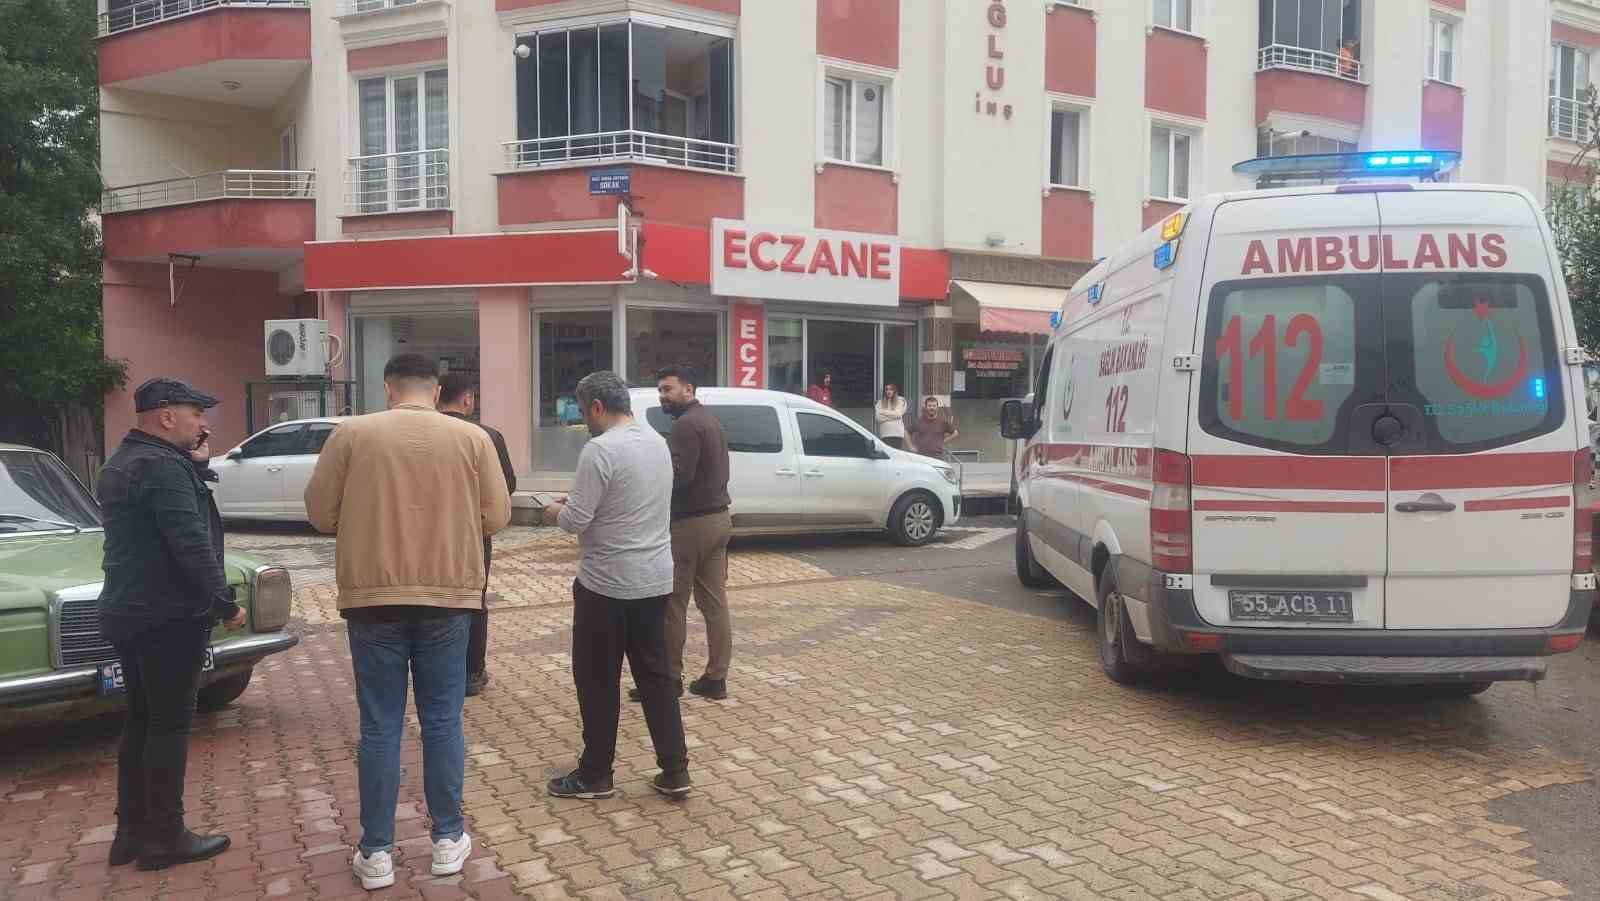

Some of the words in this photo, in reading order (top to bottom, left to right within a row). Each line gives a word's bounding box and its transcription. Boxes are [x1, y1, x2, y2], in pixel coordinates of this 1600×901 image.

[723, 228, 892, 281] ECZANE
[1240, 233, 1508, 275] AMBULANS
[1216, 312, 1325, 423] 112
[1105, 384, 1129, 433] 112
[1241, 594, 1268, 613] 55
[1276, 594, 1317, 614] ACB
[1327, 595, 1350, 614] 11
